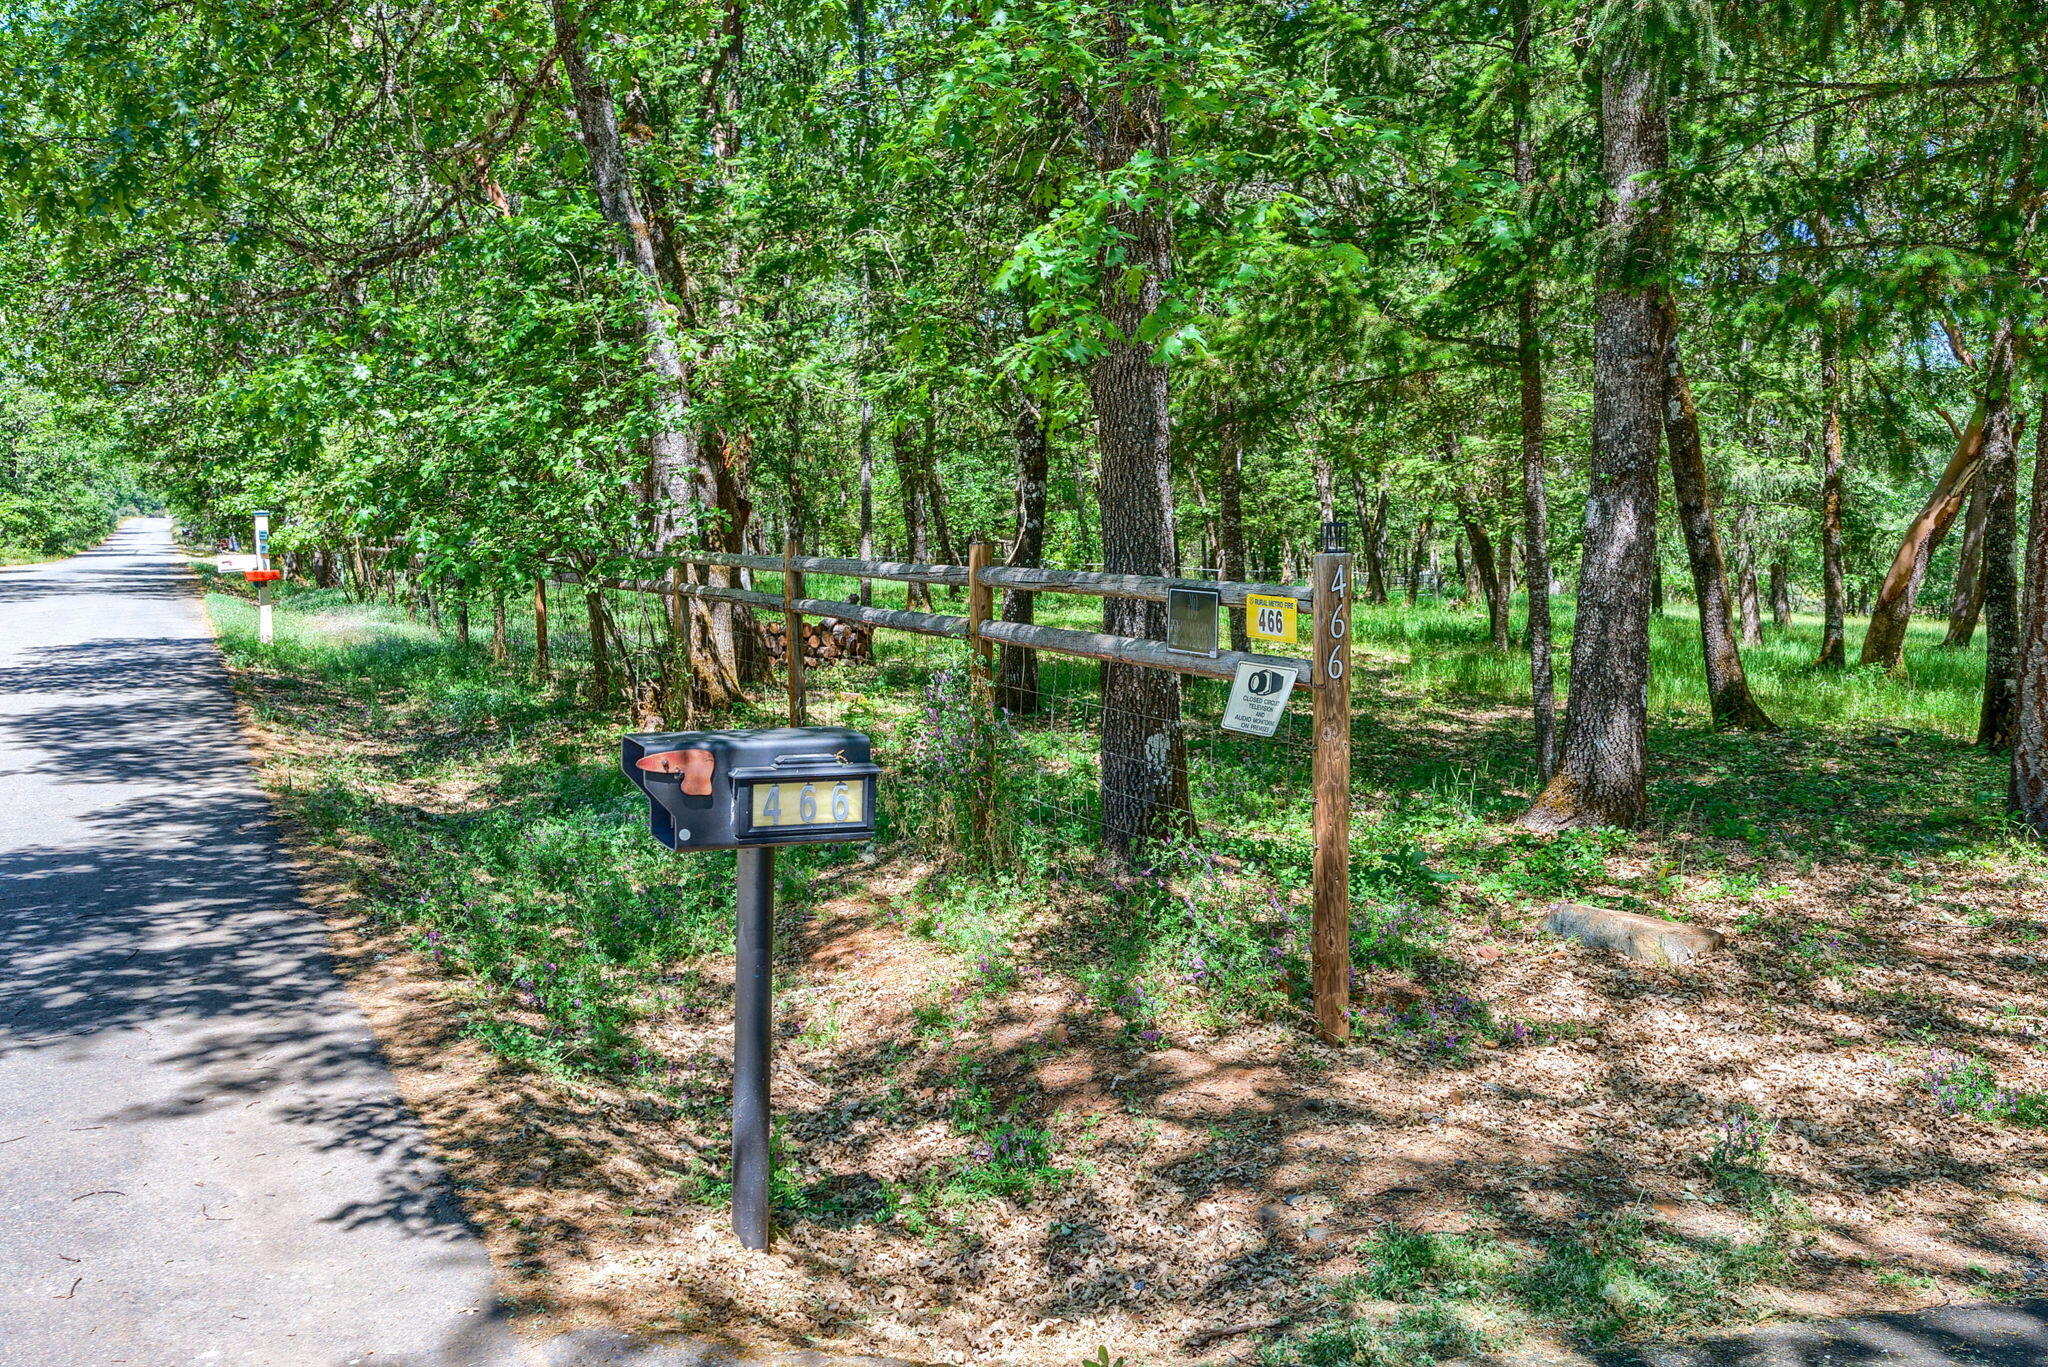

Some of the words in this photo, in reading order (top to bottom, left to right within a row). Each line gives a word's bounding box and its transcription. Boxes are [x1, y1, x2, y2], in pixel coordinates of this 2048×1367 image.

[1254, 598, 1268, 606] RURAL
[1269, 599, 1283, 608] METRO
[1284, 601, 1294, 610] FIRE
[1259, 609, 1283, 633] 466
[1327, 564, 1347, 679] 466
[1243, 695, 1263, 703] CLOSED
[1249, 703, 1273, 712] TELEVISION
[1235, 714, 1251, 722] AUDIO
[762, 782, 850, 826] 466
